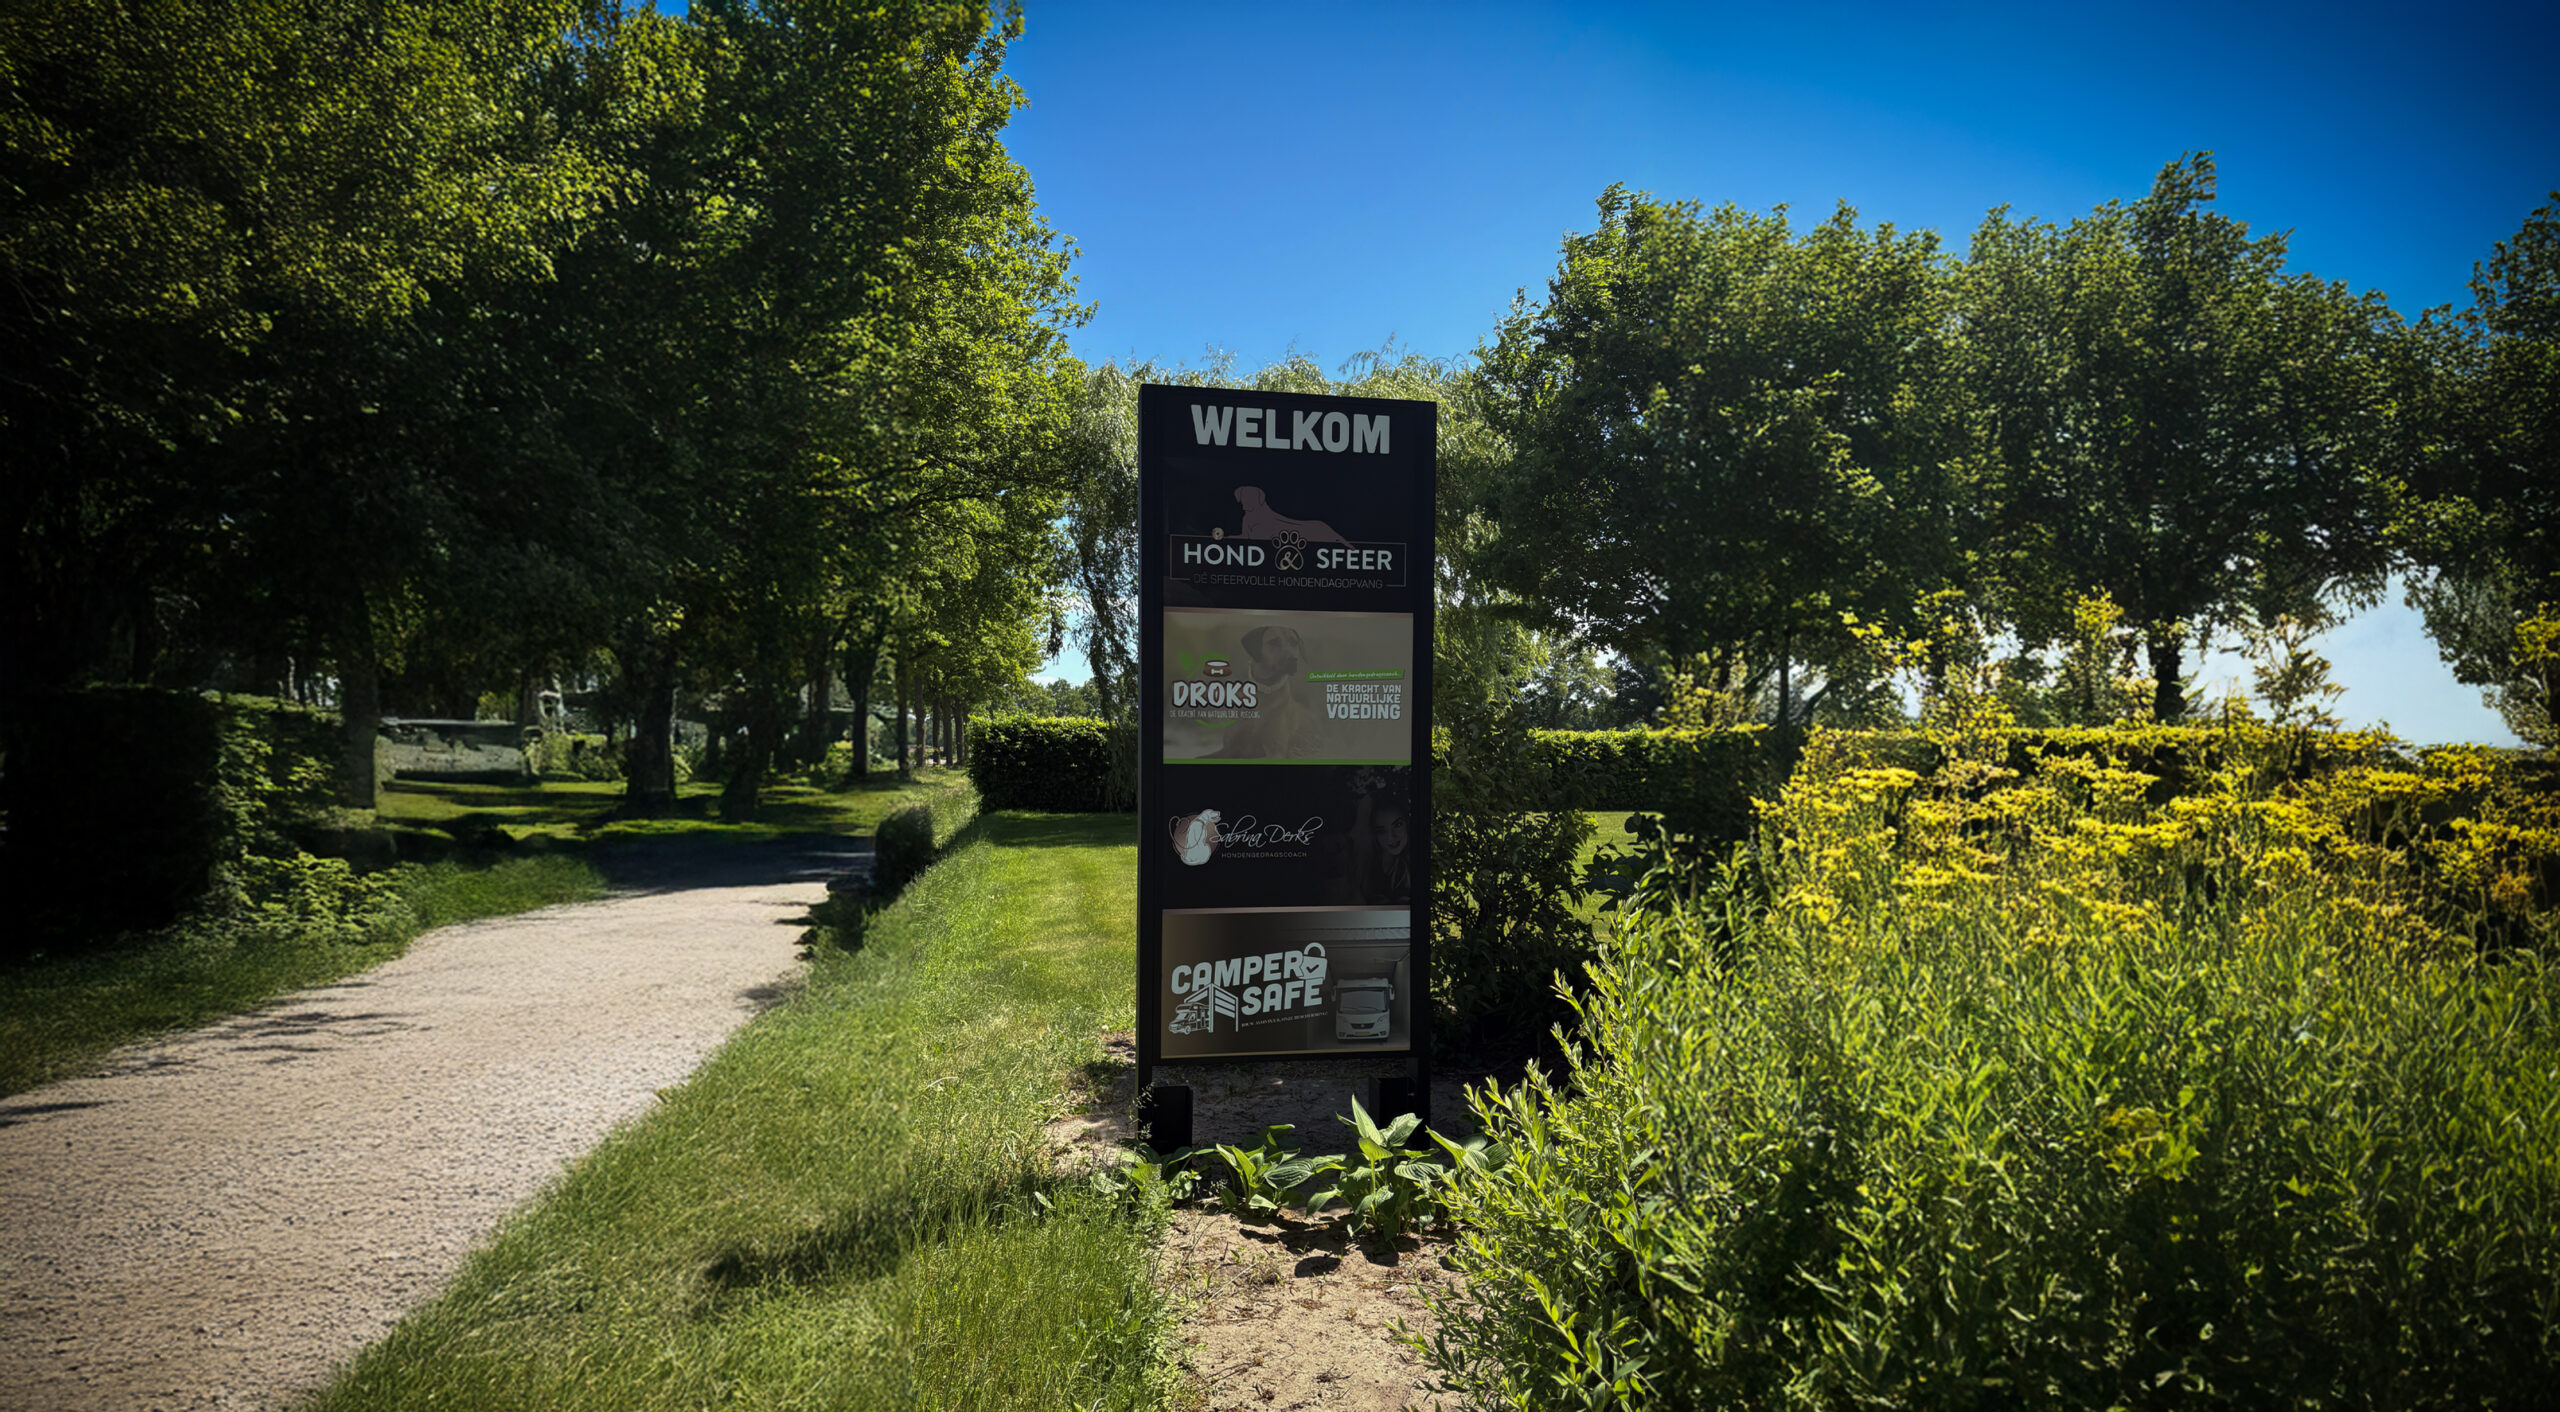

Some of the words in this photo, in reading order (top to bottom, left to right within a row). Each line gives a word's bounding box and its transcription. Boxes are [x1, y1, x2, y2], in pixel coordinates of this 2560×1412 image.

[1191, 404, 1390, 454] WELKOM
[1183, 543, 1265, 567] HOND
[1316, 548, 1393, 571] SFEER
[1193, 574, 1207, 584] DE
[1210, 574, 1276, 586] SFEERVOLLE
[1278, 576, 1383, 589] HONDENDAGOPVANG
[1172, 680, 1258, 708] DROKS
[1326, 684, 1339, 693] DE
[1341, 684, 1379, 693] KRACHT
[1382, 684, 1401, 694] VAN
[1326, 693, 1401, 704] NATUURLIJKE
[1326, 703, 1401, 720] VOEDING
[1209, 814, 1266, 848] Sabrina
[1263, 816, 1324, 846] Derks
[1221, 851, 1307, 859] HONDENGEDRAGSCOACH
[1171, 950, 1305, 995] CAMPER
[1241, 977, 1325, 1016] SAFE
